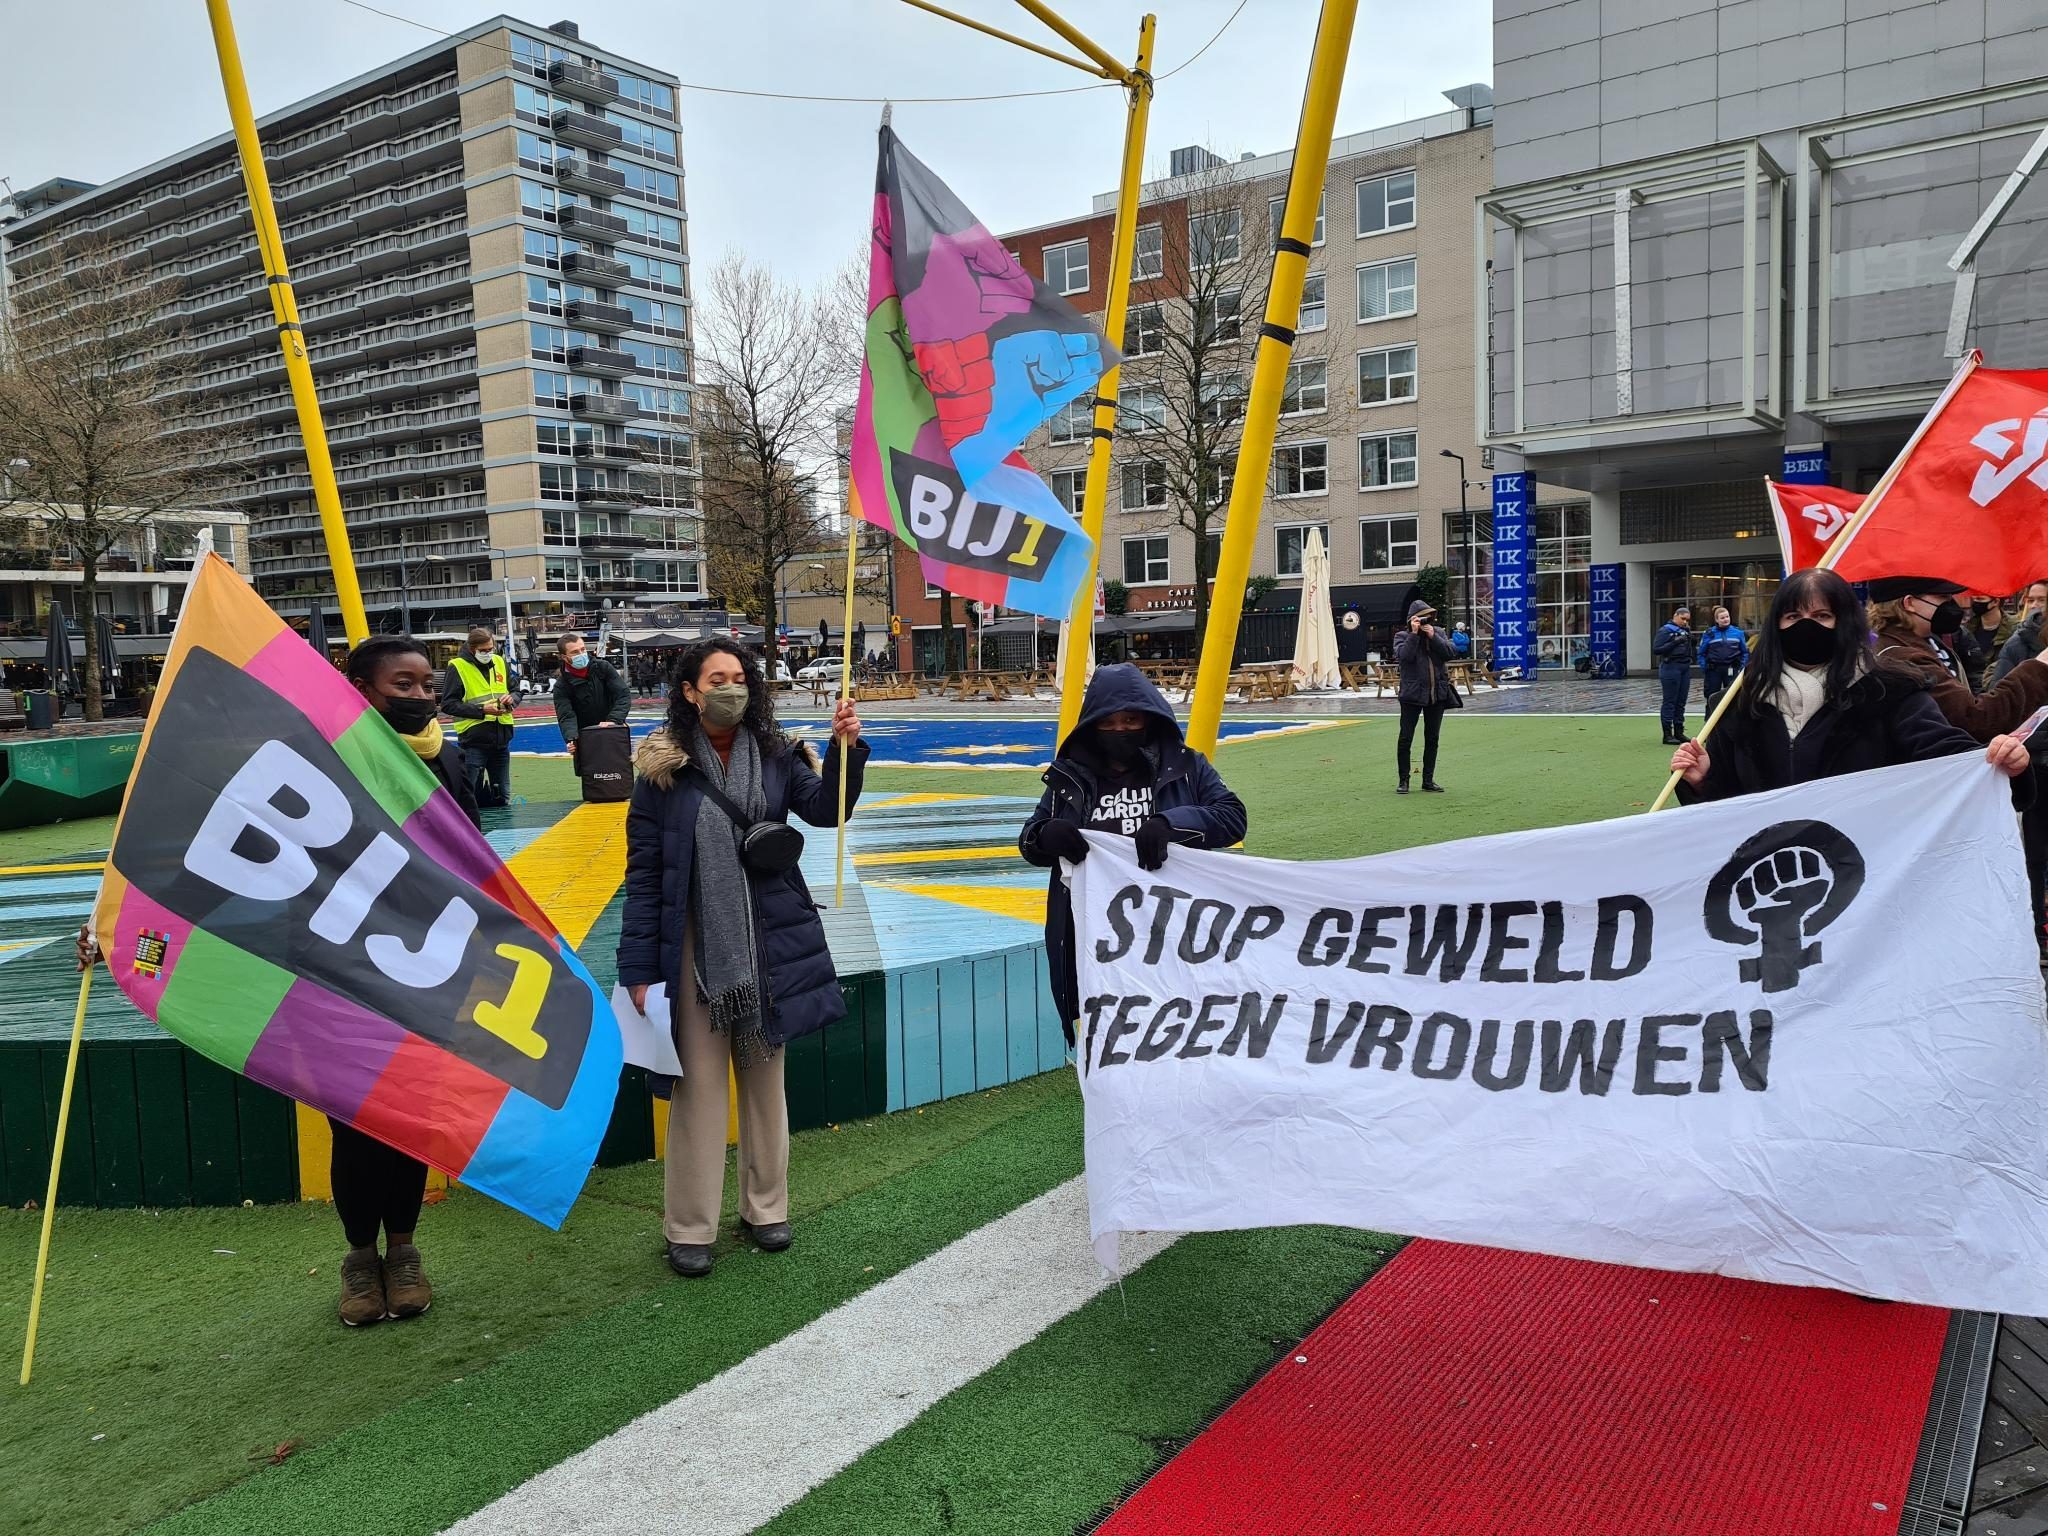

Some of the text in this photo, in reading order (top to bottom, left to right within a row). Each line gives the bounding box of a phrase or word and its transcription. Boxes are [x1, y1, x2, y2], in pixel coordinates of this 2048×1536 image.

[1783, 459, 1823, 474] BEN
[1496, 477, 1521, 494] IK
[1496, 501, 1521, 518] IK
[910, 474, 1047, 567] BIJ1
[1497, 525, 1522, 541] IK
[1497, 549, 1521, 565] IK
[1497, 573, 1522, 589] IK
[1593, 568, 1615, 582] IK
[1168, 587, 1195, 597] CAFÉ
[1593, 589, 1615, 603] IK
[1147, 600, 1210, 608] RESTAUR
[1497, 597, 1522, 613] IK
[1593, 610, 1615, 623] IK
[1498, 621, 1522, 637] IK
[1593, 630, 1615, 643] IK
[1498, 645, 1522, 660] IK
[1090, 801, 1151, 821] AARDI
[184, 739, 553, 1060] BIJ1
[1096, 884, 1653, 983] STOP GEWELD
[1084, 991, 1773, 1096] TEGEN VROUWEN
